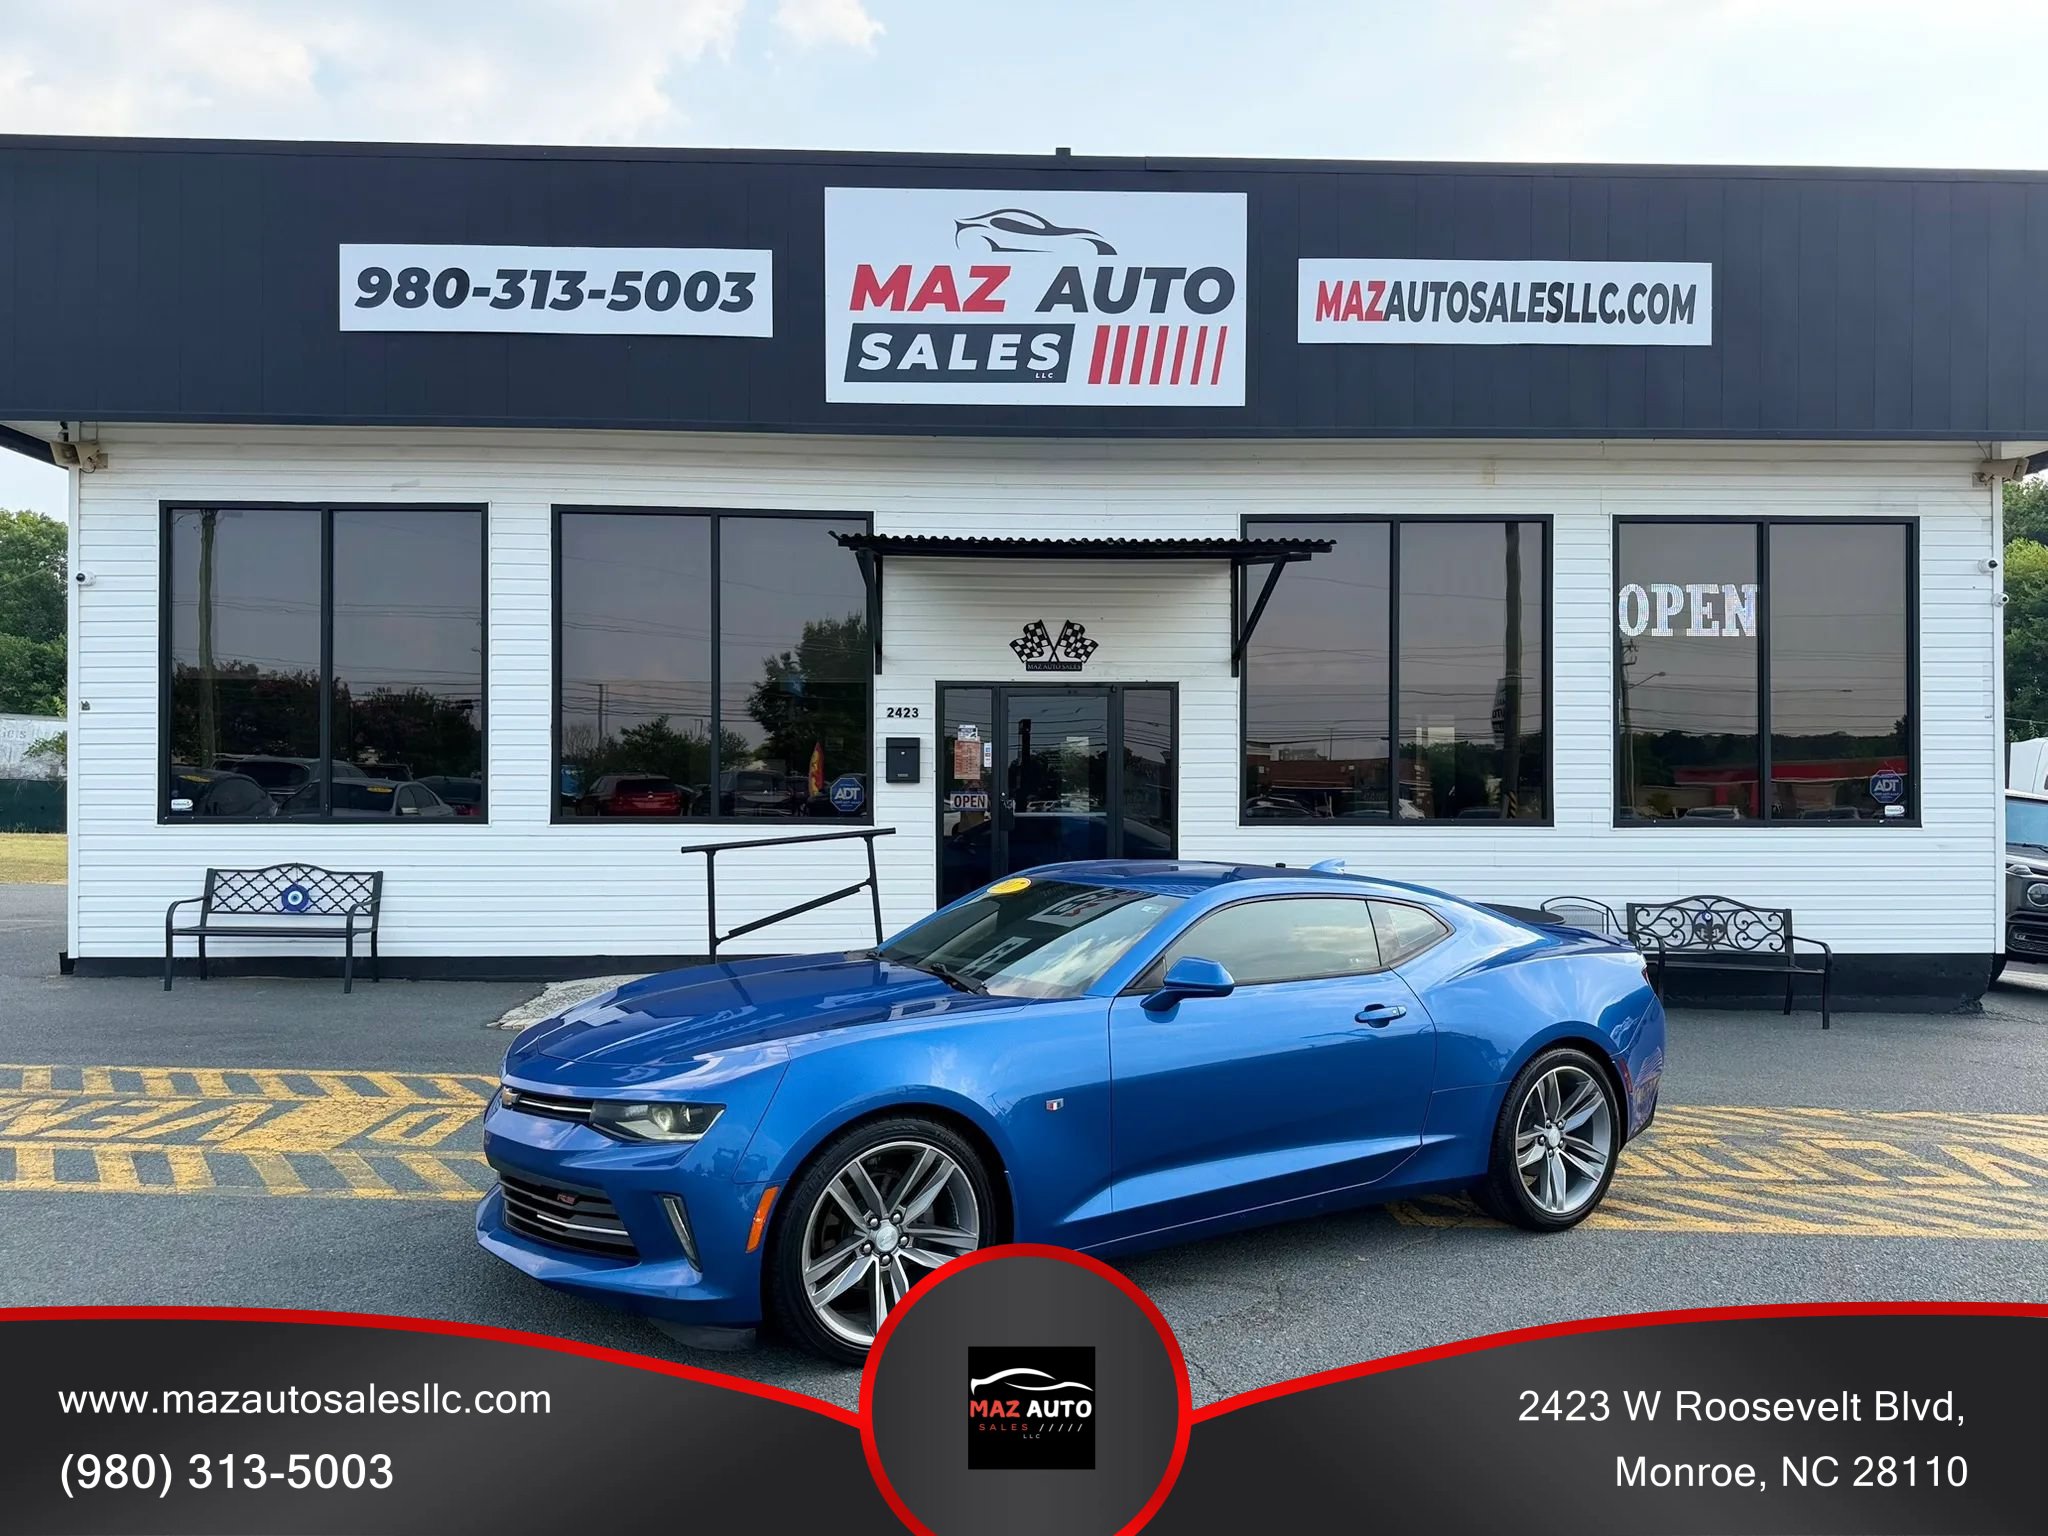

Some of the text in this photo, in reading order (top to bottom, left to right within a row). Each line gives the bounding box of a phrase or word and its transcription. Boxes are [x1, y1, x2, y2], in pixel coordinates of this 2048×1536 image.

[355, 266, 756, 313] 980-313-5003
[850, 264, 1236, 314] MAZ AUTO
[1315, 280, 1697, 325] MAZAUTOSALESLLC.COM
[857, 332, 1062, 371] SALES
[1618, 583, 1758, 637] OPEN
[887, 707, 919, 718] 2423
[834, 787, 861, 800] ADT
[954, 795, 985, 808] OPEN
[1873, 779, 1899, 792] ADT
